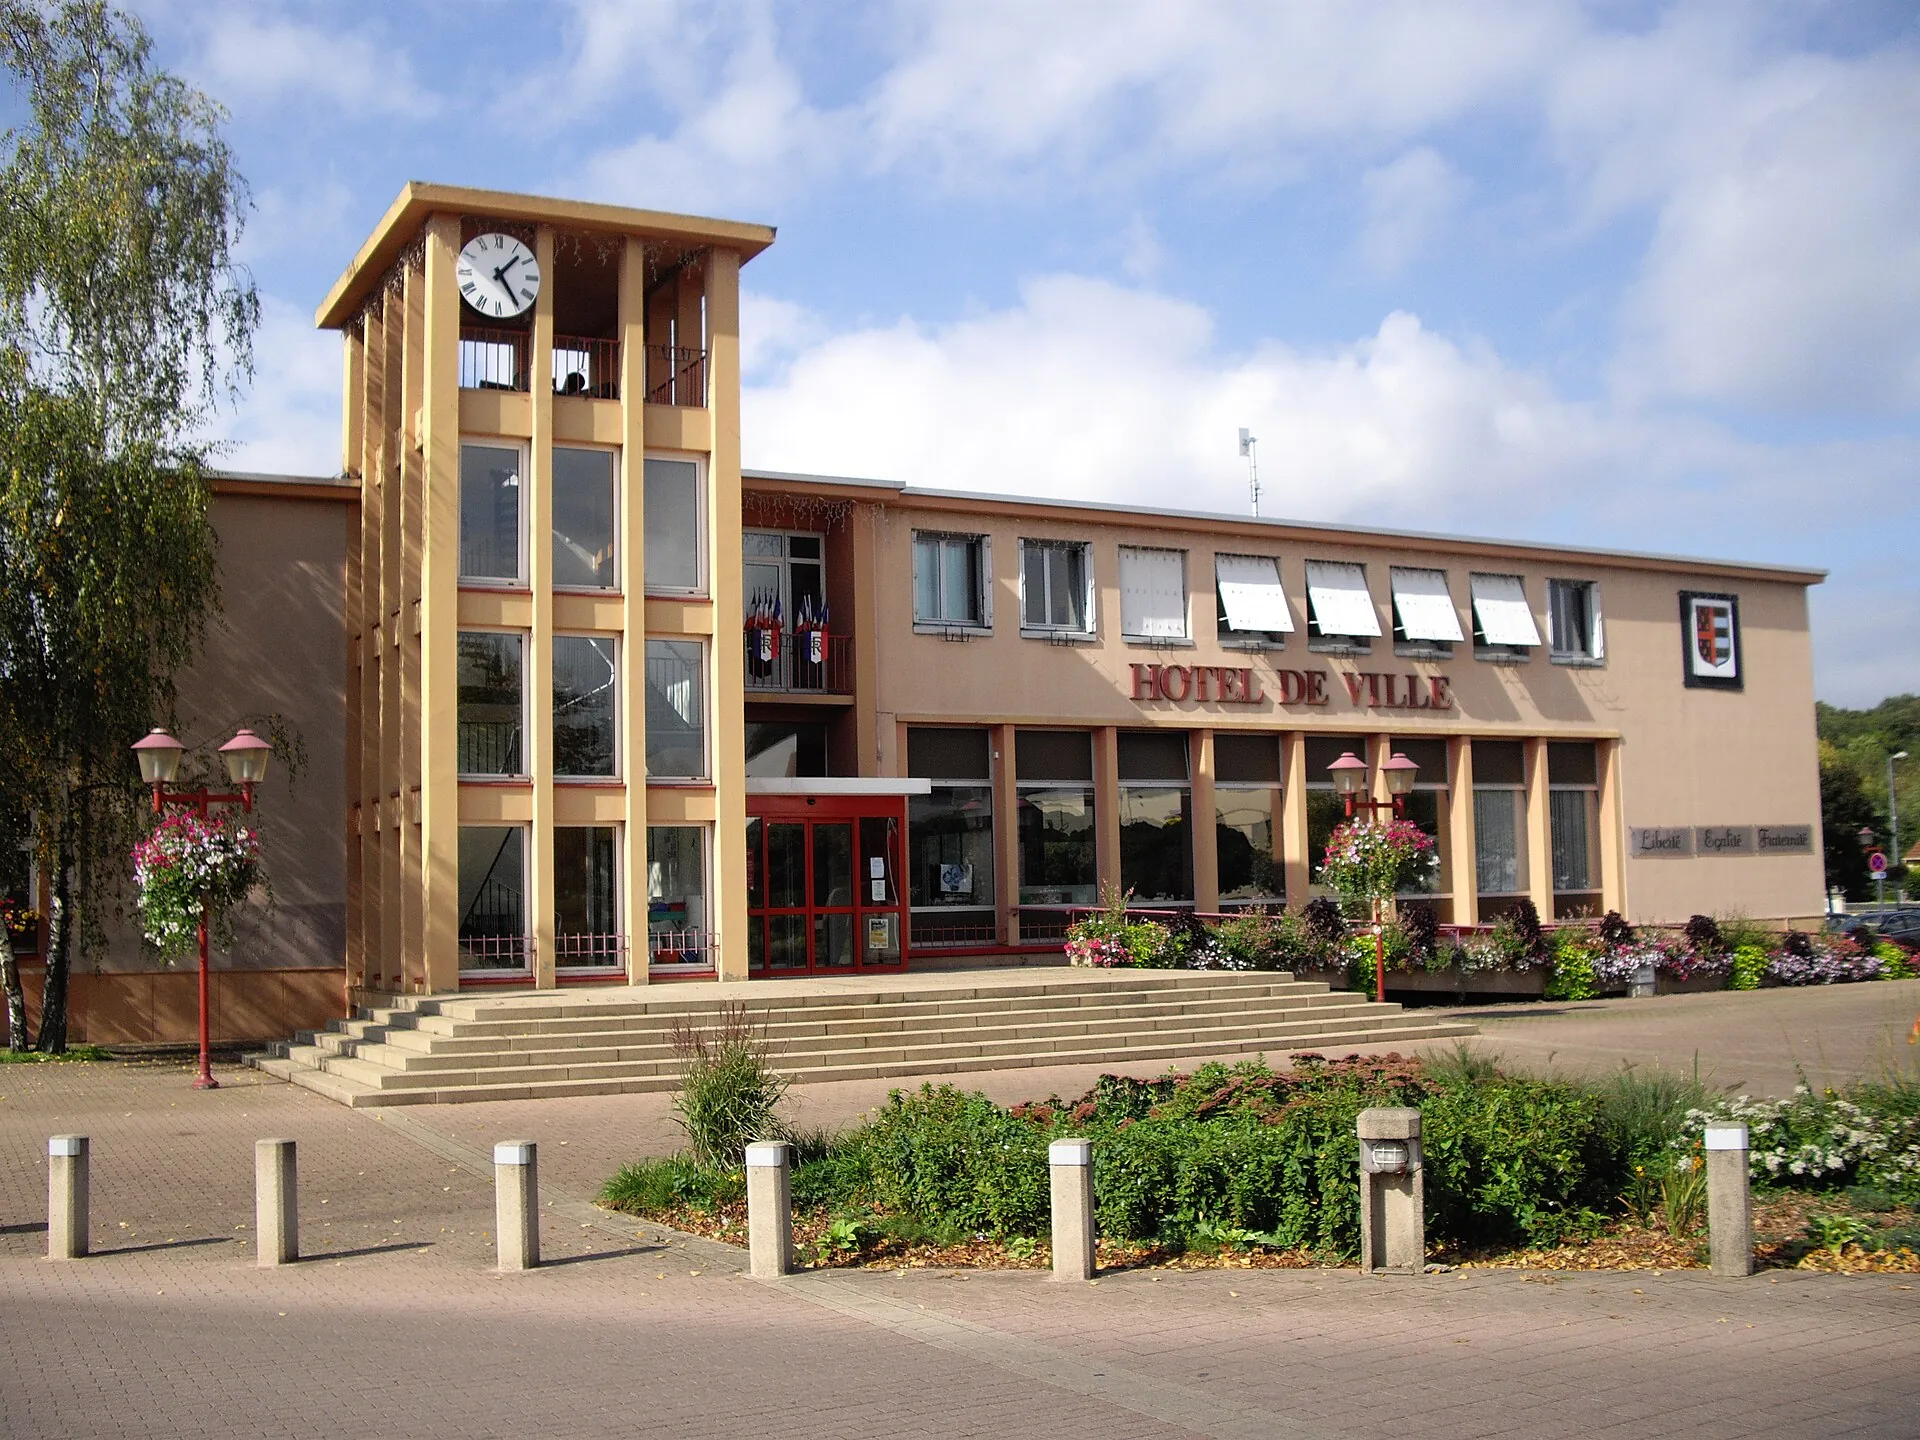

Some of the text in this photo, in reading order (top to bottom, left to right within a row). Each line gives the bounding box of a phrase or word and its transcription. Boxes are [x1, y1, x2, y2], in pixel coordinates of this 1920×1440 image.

[1129, 663, 1453, 710] HOTEL DE VILLE
[1641, 829, 1681, 850] Liberté
